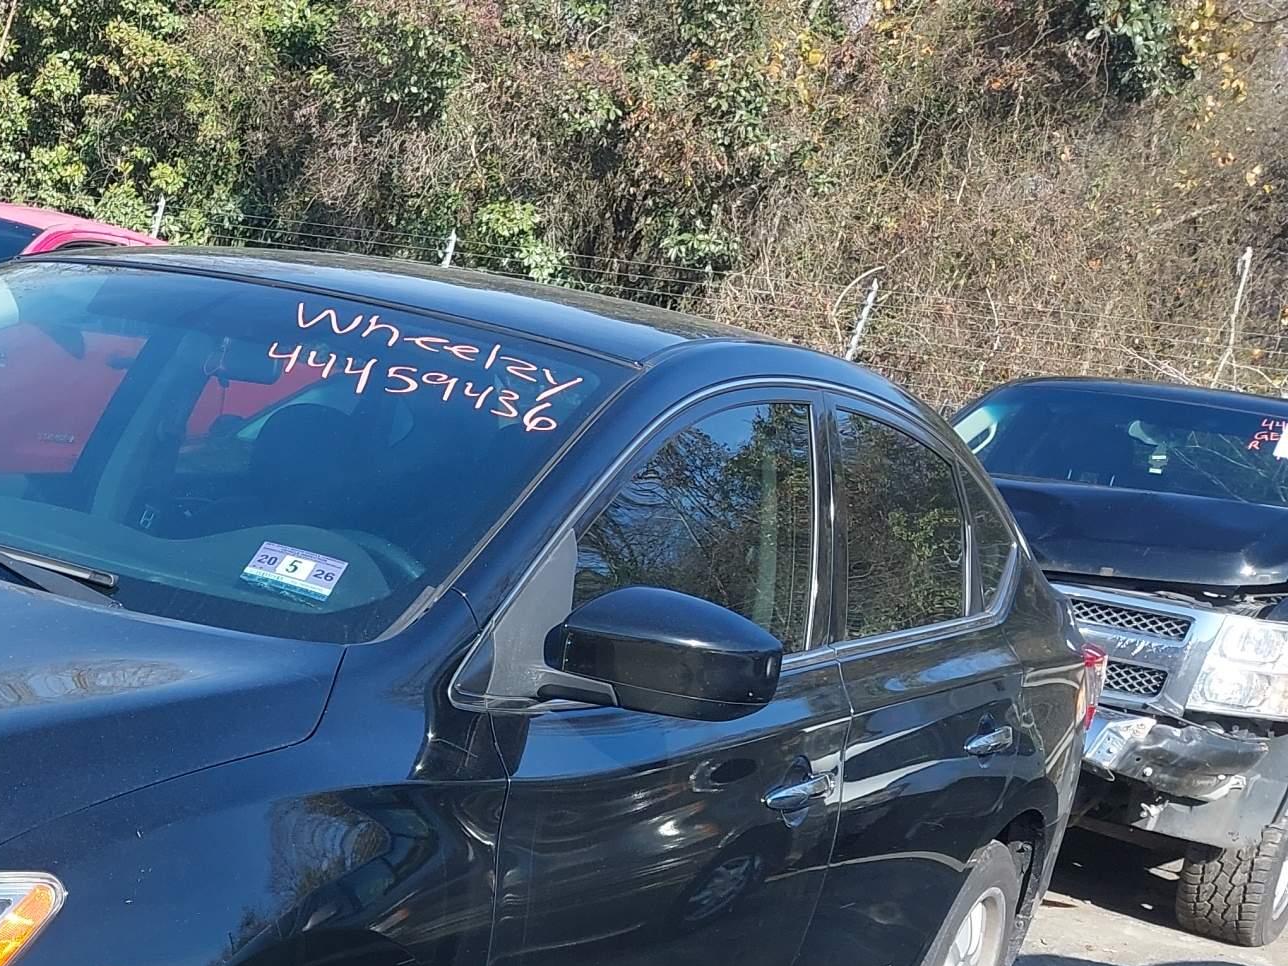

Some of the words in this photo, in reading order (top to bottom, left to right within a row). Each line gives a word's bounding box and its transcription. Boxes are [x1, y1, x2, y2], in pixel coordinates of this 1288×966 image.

[268, 342, 557, 432] 44459436
[1247, 440, 1260, 450] R
[256, 554, 278, 567] 20
[285, 559, 303, 574] 5
[313, 568, 336, 582] 26
